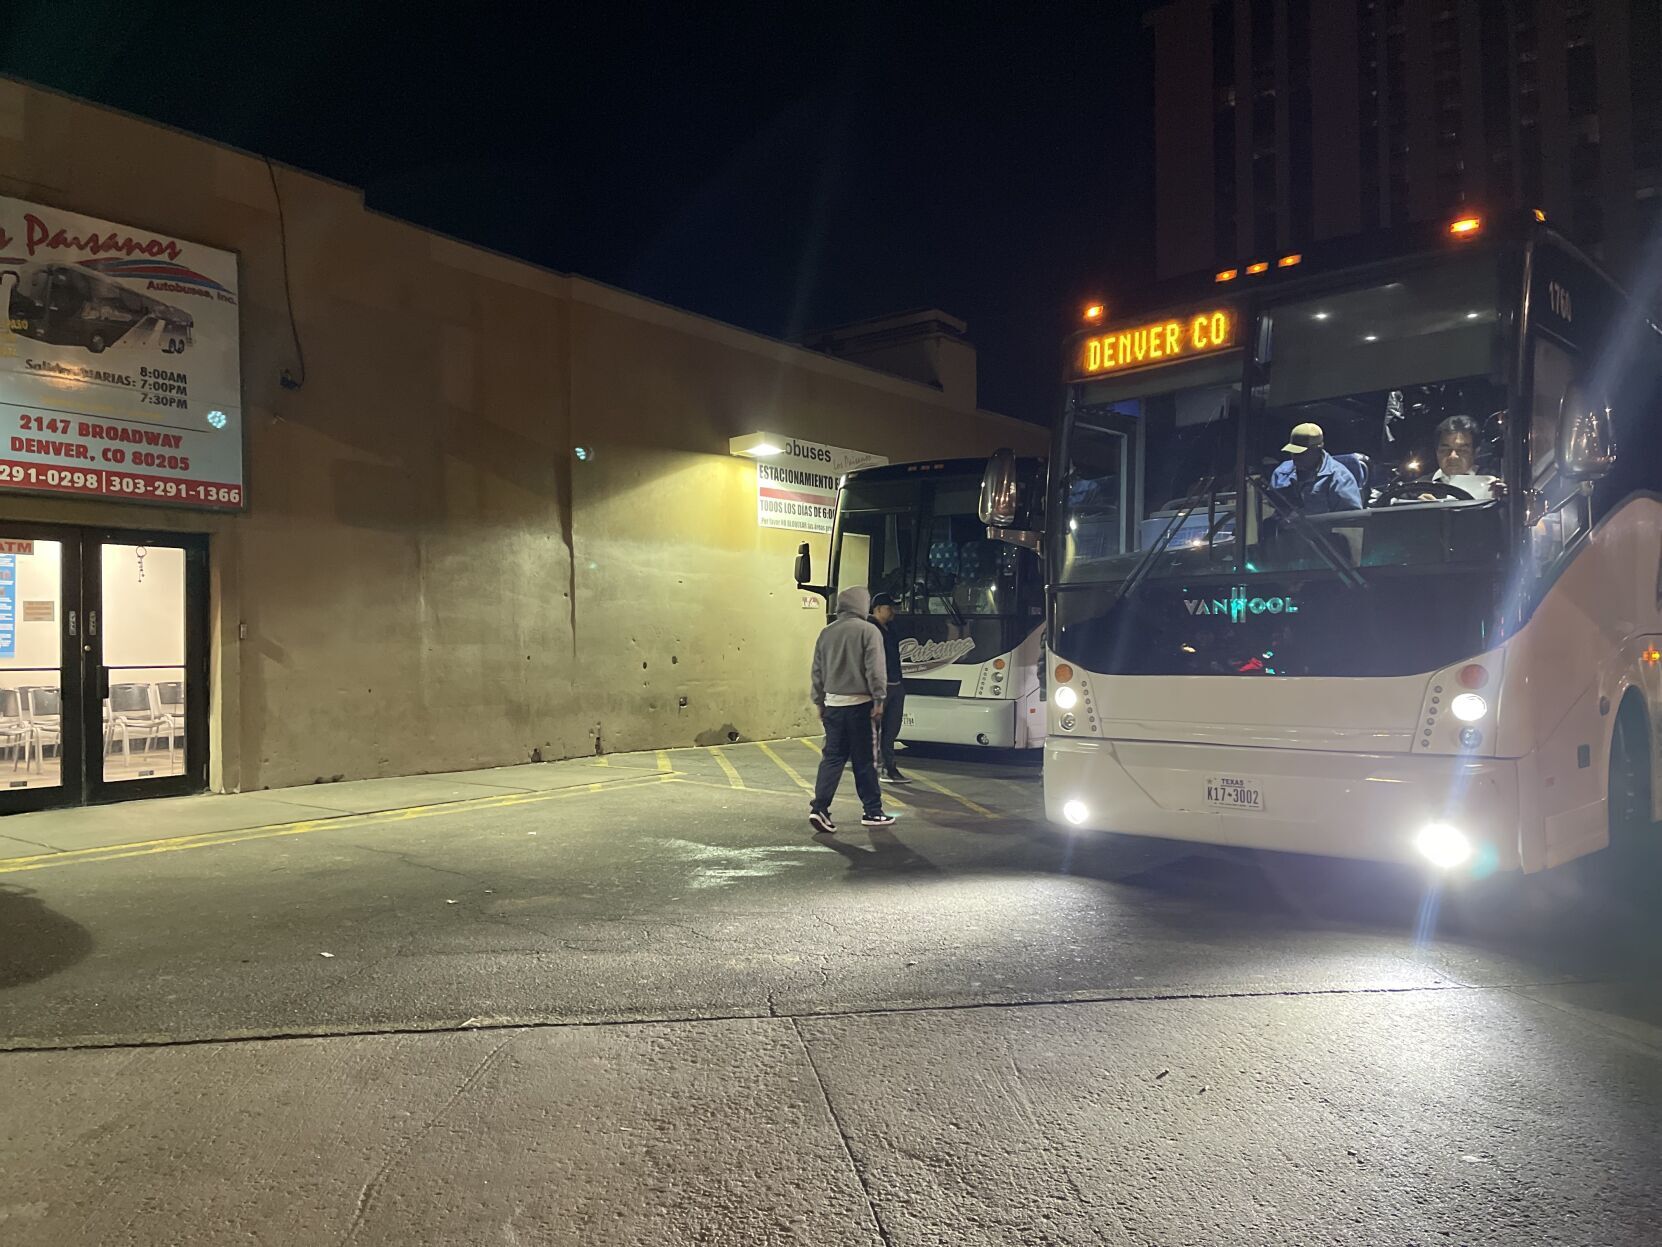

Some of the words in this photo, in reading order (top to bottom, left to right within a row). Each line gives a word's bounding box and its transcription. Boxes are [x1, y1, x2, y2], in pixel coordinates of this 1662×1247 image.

[24, 213, 182, 261] Paisanos
[146, 280, 213, 300] Autobuses,
[216, 291, 238, 306] Inc.
[1088, 322, 1180, 372] DENVER
[1193, 312, 1226, 348] CO
[140, 366, 187, 384] 8:00AM
[140, 379, 188, 396] 7:00PM
[140, 393, 188, 410] 7:30PM
[19, 414, 71, 435] 2147
[78, 422, 183, 449] BROADWAY
[10, 436, 96, 462] DENVER,
[102, 447, 126, 464] CO
[131, 451, 190, 471] 80205
[785, 440, 832, 463] obuses
[110, 476, 240, 503] 303-291-1366
[760, 465, 833, 490] ESTACIONAMIENTO
[760, 500, 783, 514] TODOS
[784, 503, 796, 516] LOS
[813, 507, 822, 519] DE
